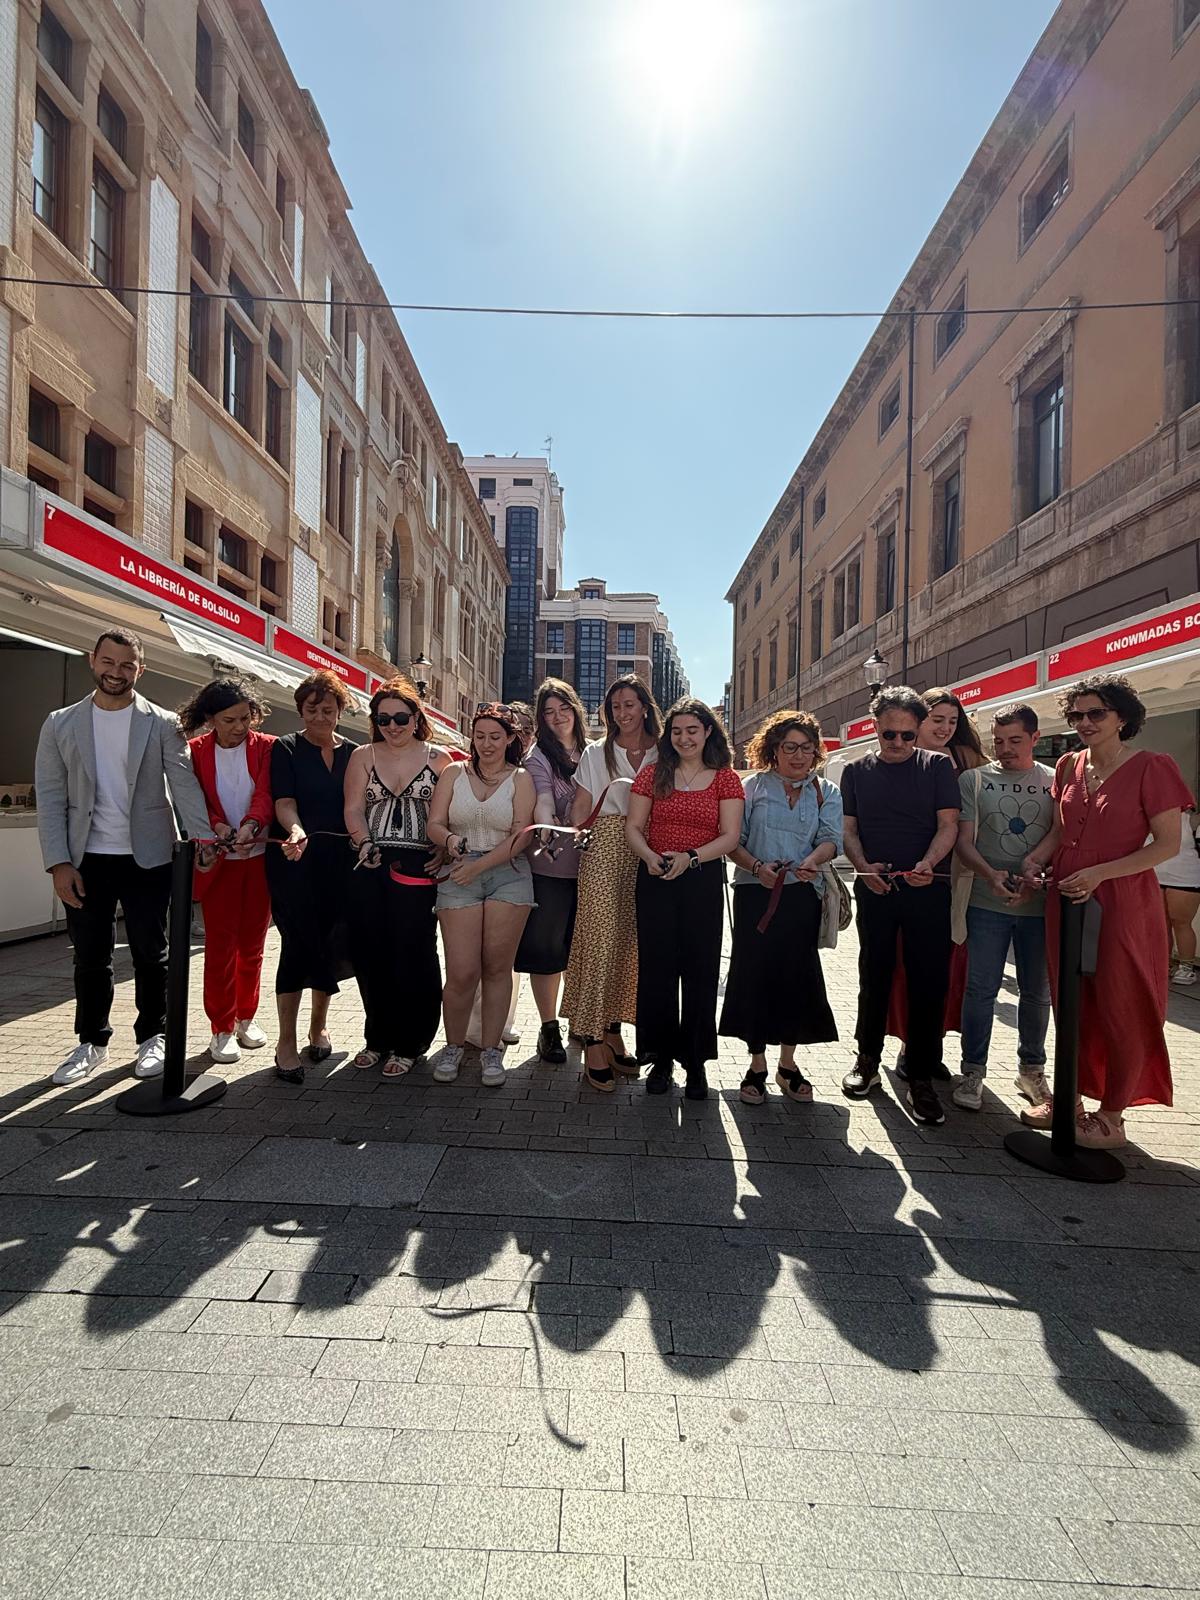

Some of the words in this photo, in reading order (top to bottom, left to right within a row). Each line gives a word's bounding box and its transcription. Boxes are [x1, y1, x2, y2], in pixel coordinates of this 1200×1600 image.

[46, 504, 56, 520] 7
[120, 555, 136, 575] LA
[138, 565, 187, 599] LIBRERÍA
[188, 590, 201, 606] DE
[202, 597, 240, 625] BOLSILLO
[1106, 619, 1181, 654] KNOWMADAS
[306, 650, 331, 669] IDENTIDAD
[331, 662, 349, 677] SECRETA
[1049, 653, 1060, 665] 22
[960, 687, 981, 701] LETRAS
